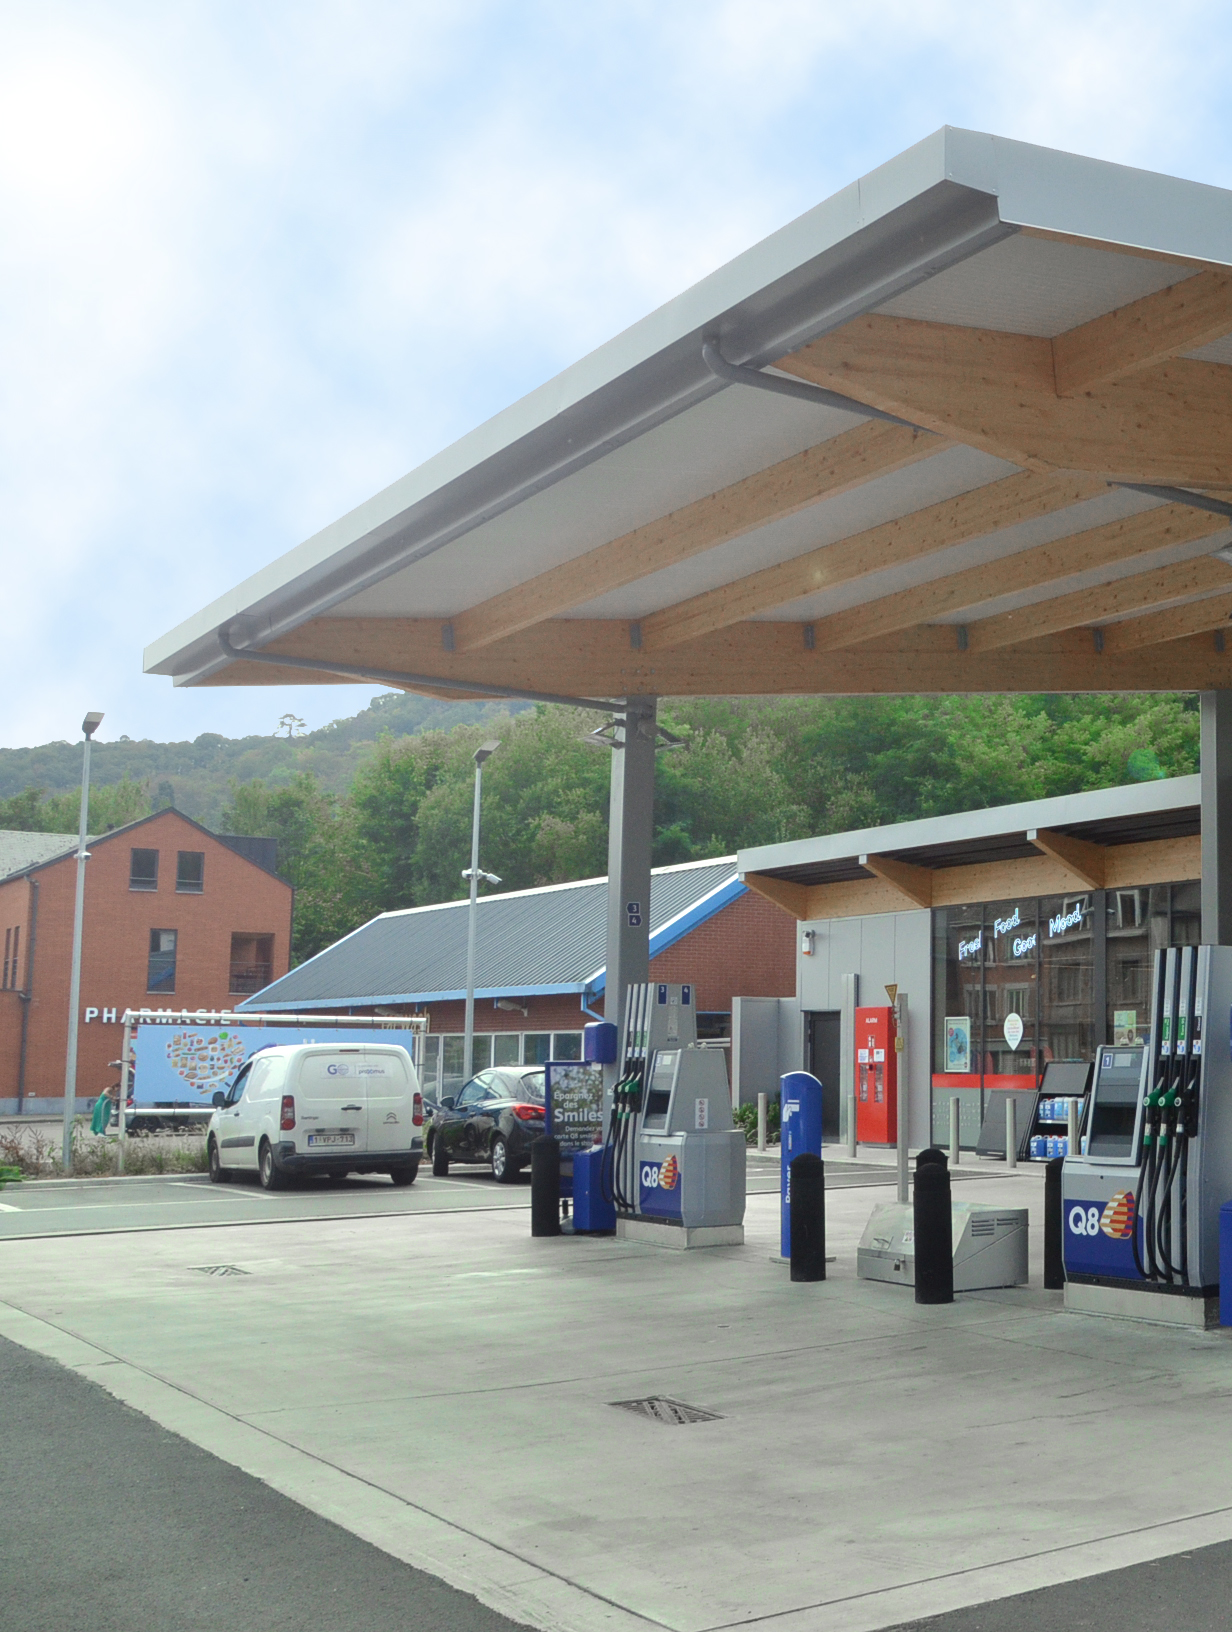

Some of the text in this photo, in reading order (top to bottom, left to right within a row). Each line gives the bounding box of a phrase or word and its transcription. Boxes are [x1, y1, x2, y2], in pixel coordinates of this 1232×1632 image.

[632, 904, 637, 912] 3
[994, 907, 1020, 938] Food
[1049, 903, 1081, 937] Mood
[1105, 1056, 1110, 1066] 1
[554, 1090, 593, 1101] Épargnez
[554, 1108, 603, 1122] Smiles
[642, 1165, 659, 1188] Q8
[1069, 1206, 1100, 1236] Q8
